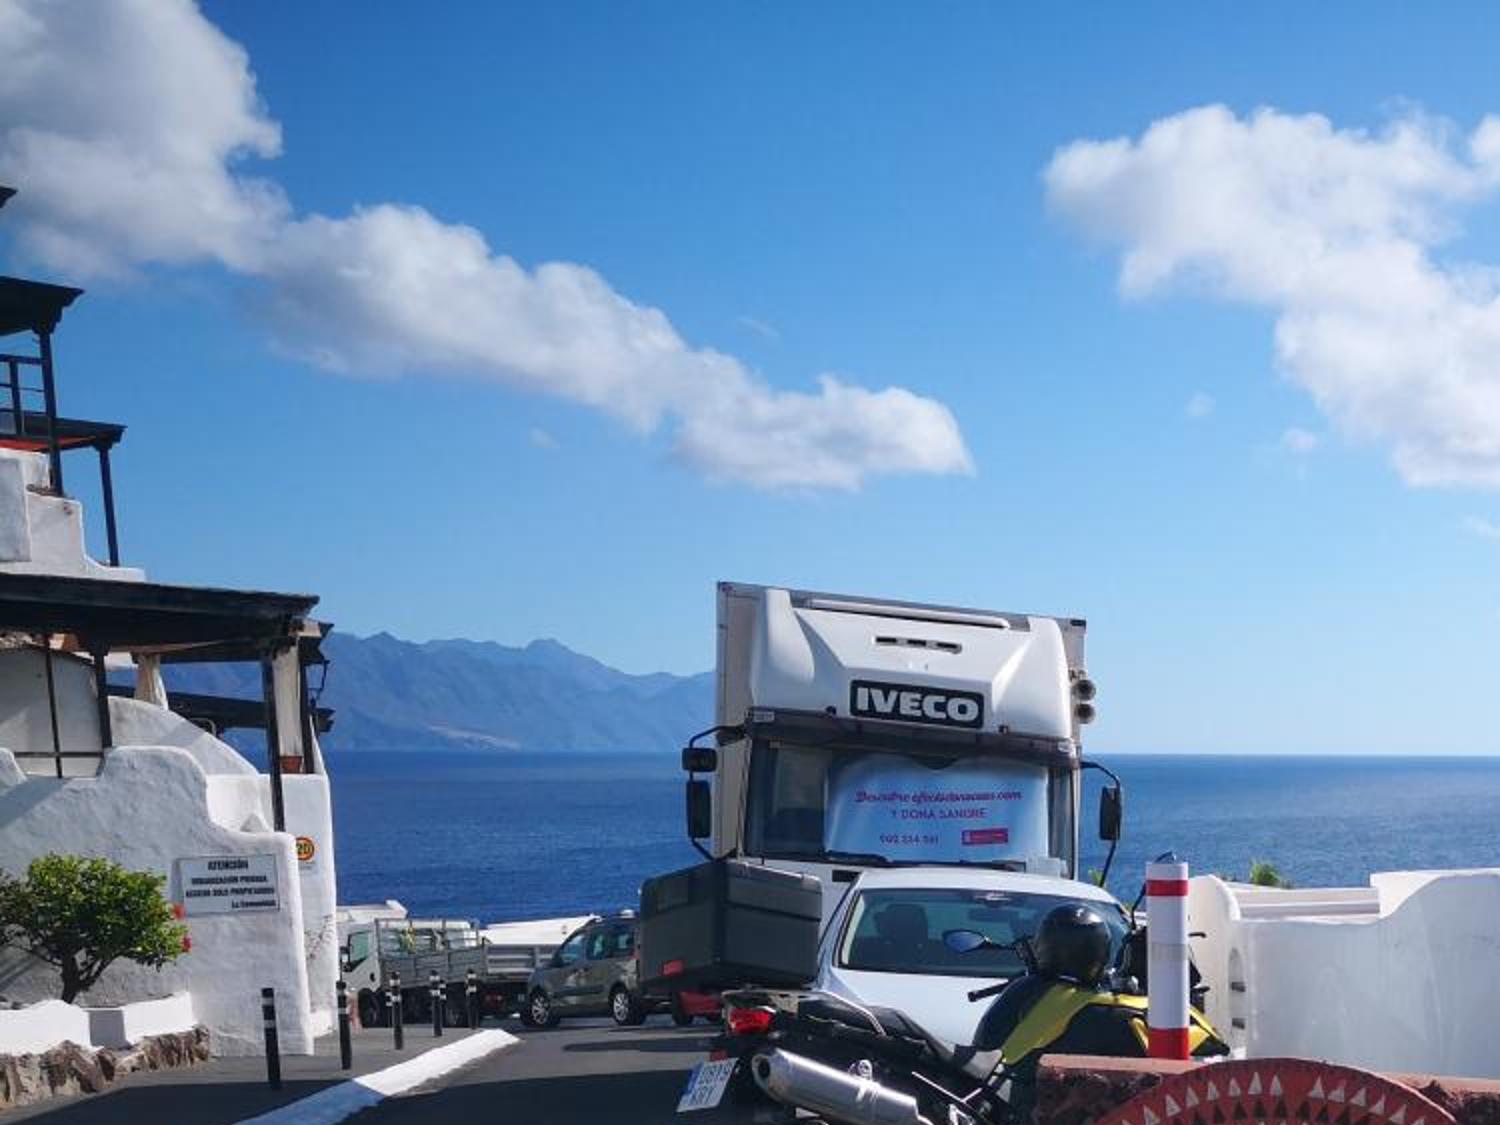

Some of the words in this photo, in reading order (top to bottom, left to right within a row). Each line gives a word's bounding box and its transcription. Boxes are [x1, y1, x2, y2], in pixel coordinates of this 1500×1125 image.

[857, 687, 980, 722] IVECO
[900, 808, 936, 821] DONA
[938, 807, 990, 820] SANGRE
